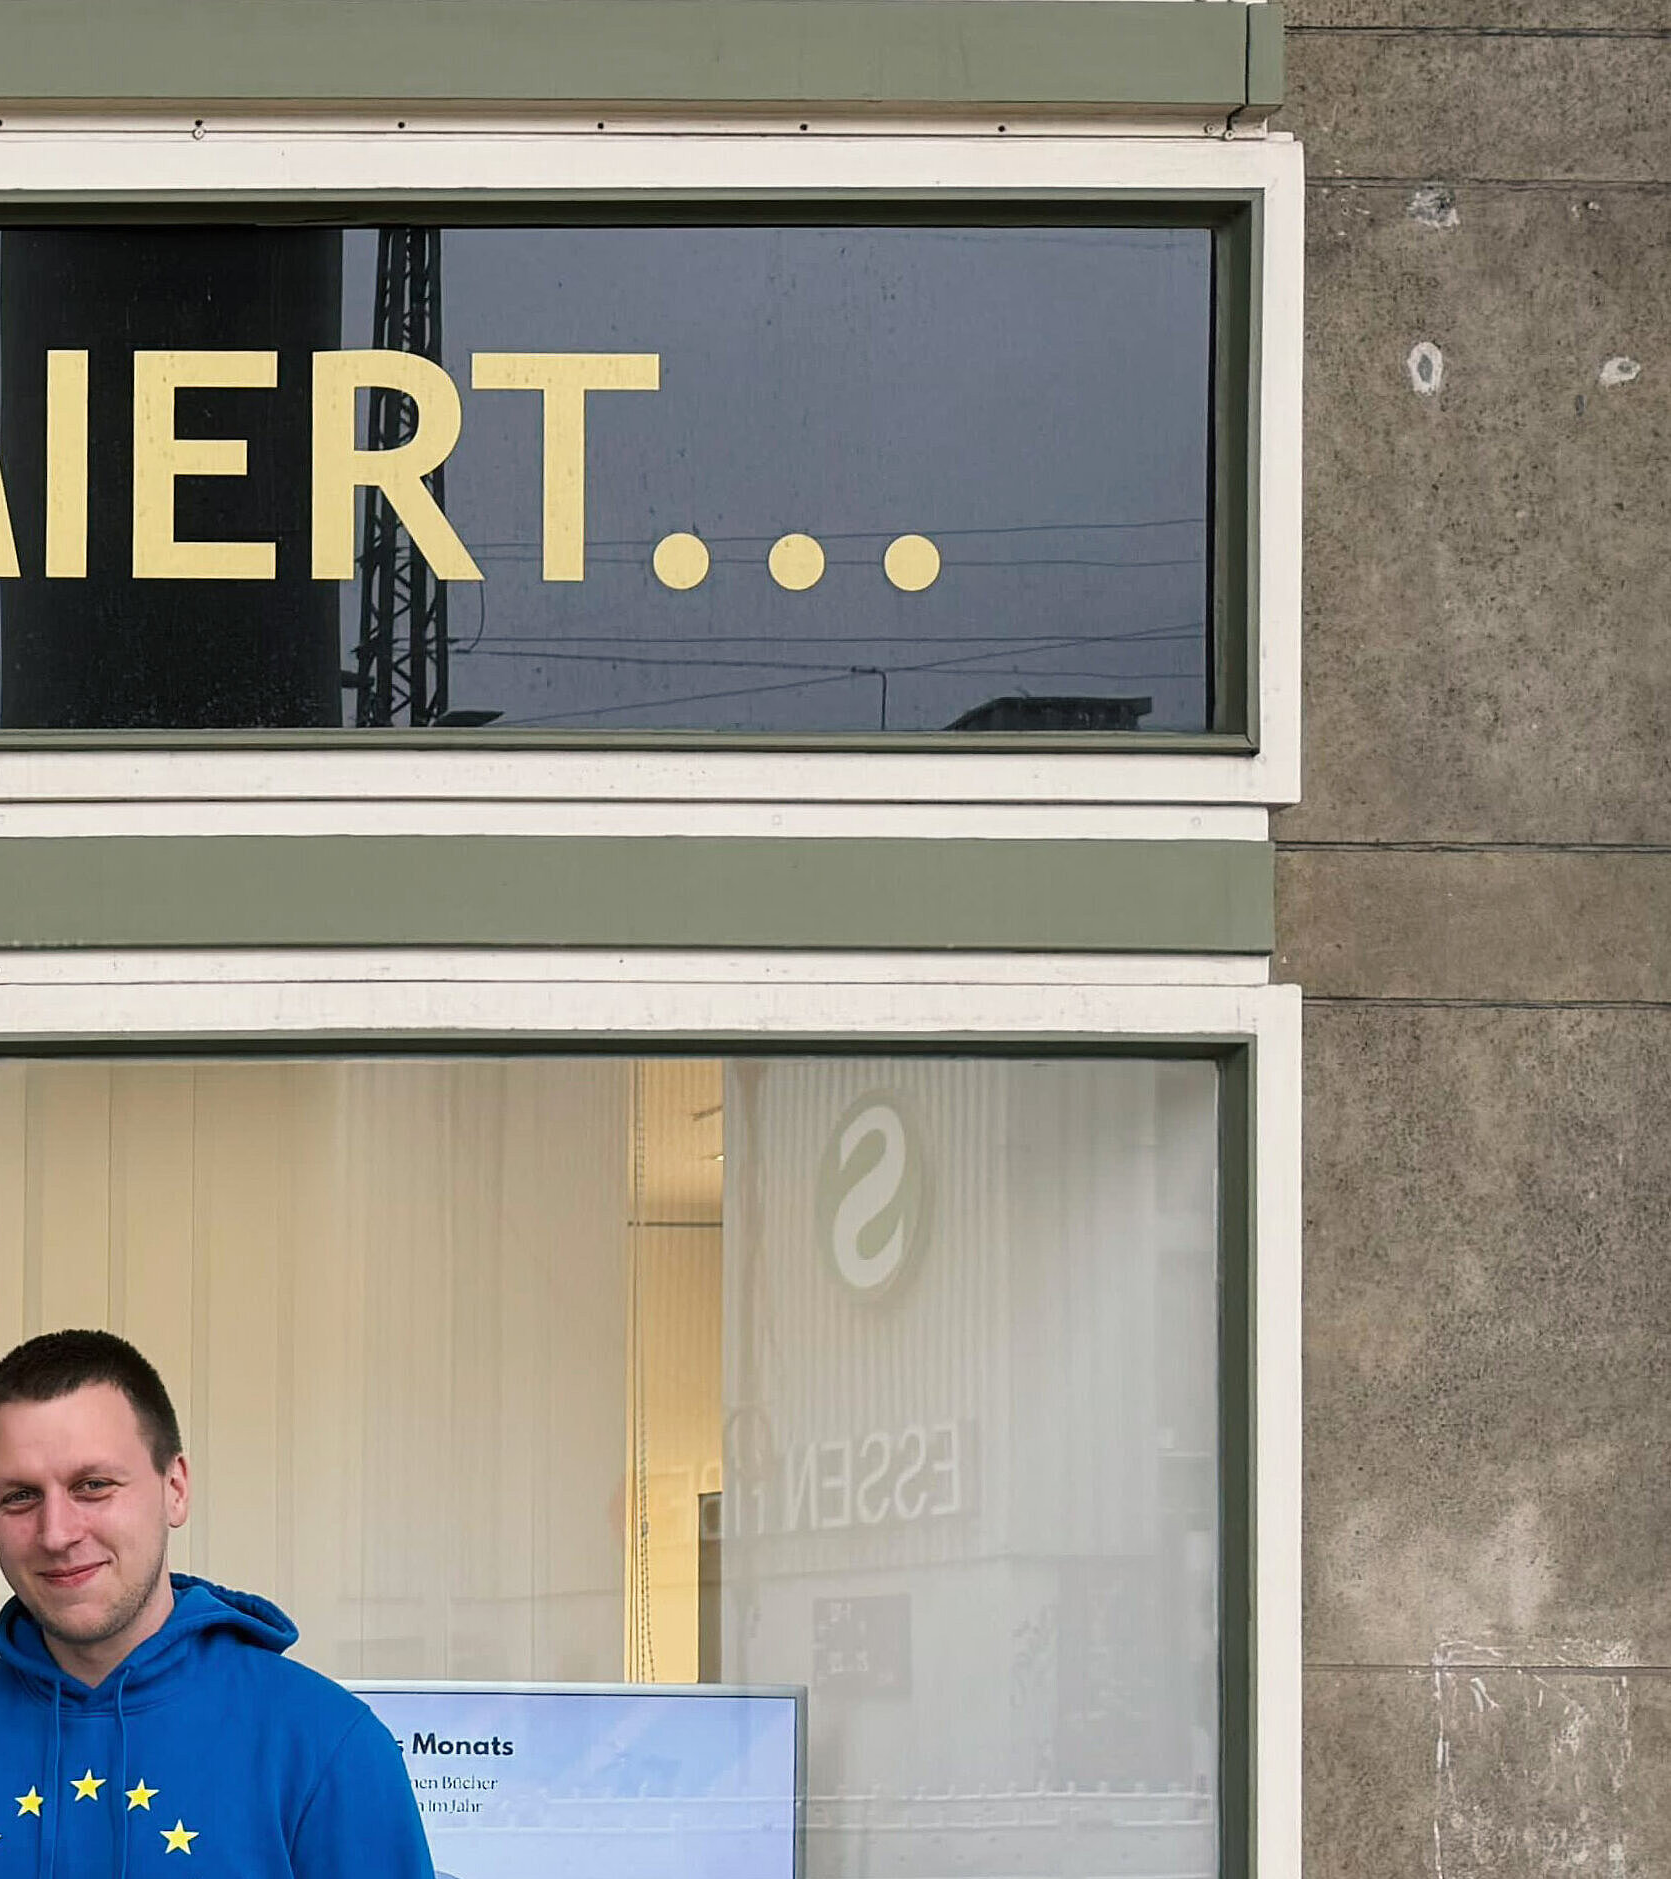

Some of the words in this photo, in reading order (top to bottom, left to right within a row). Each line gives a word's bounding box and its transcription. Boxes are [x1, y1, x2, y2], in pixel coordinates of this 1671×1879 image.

[412, 1732, 514, 1756] Monats
[442, 1775, 498, 1791] Bücher
[449, 1798, 484, 1814] Jahr
